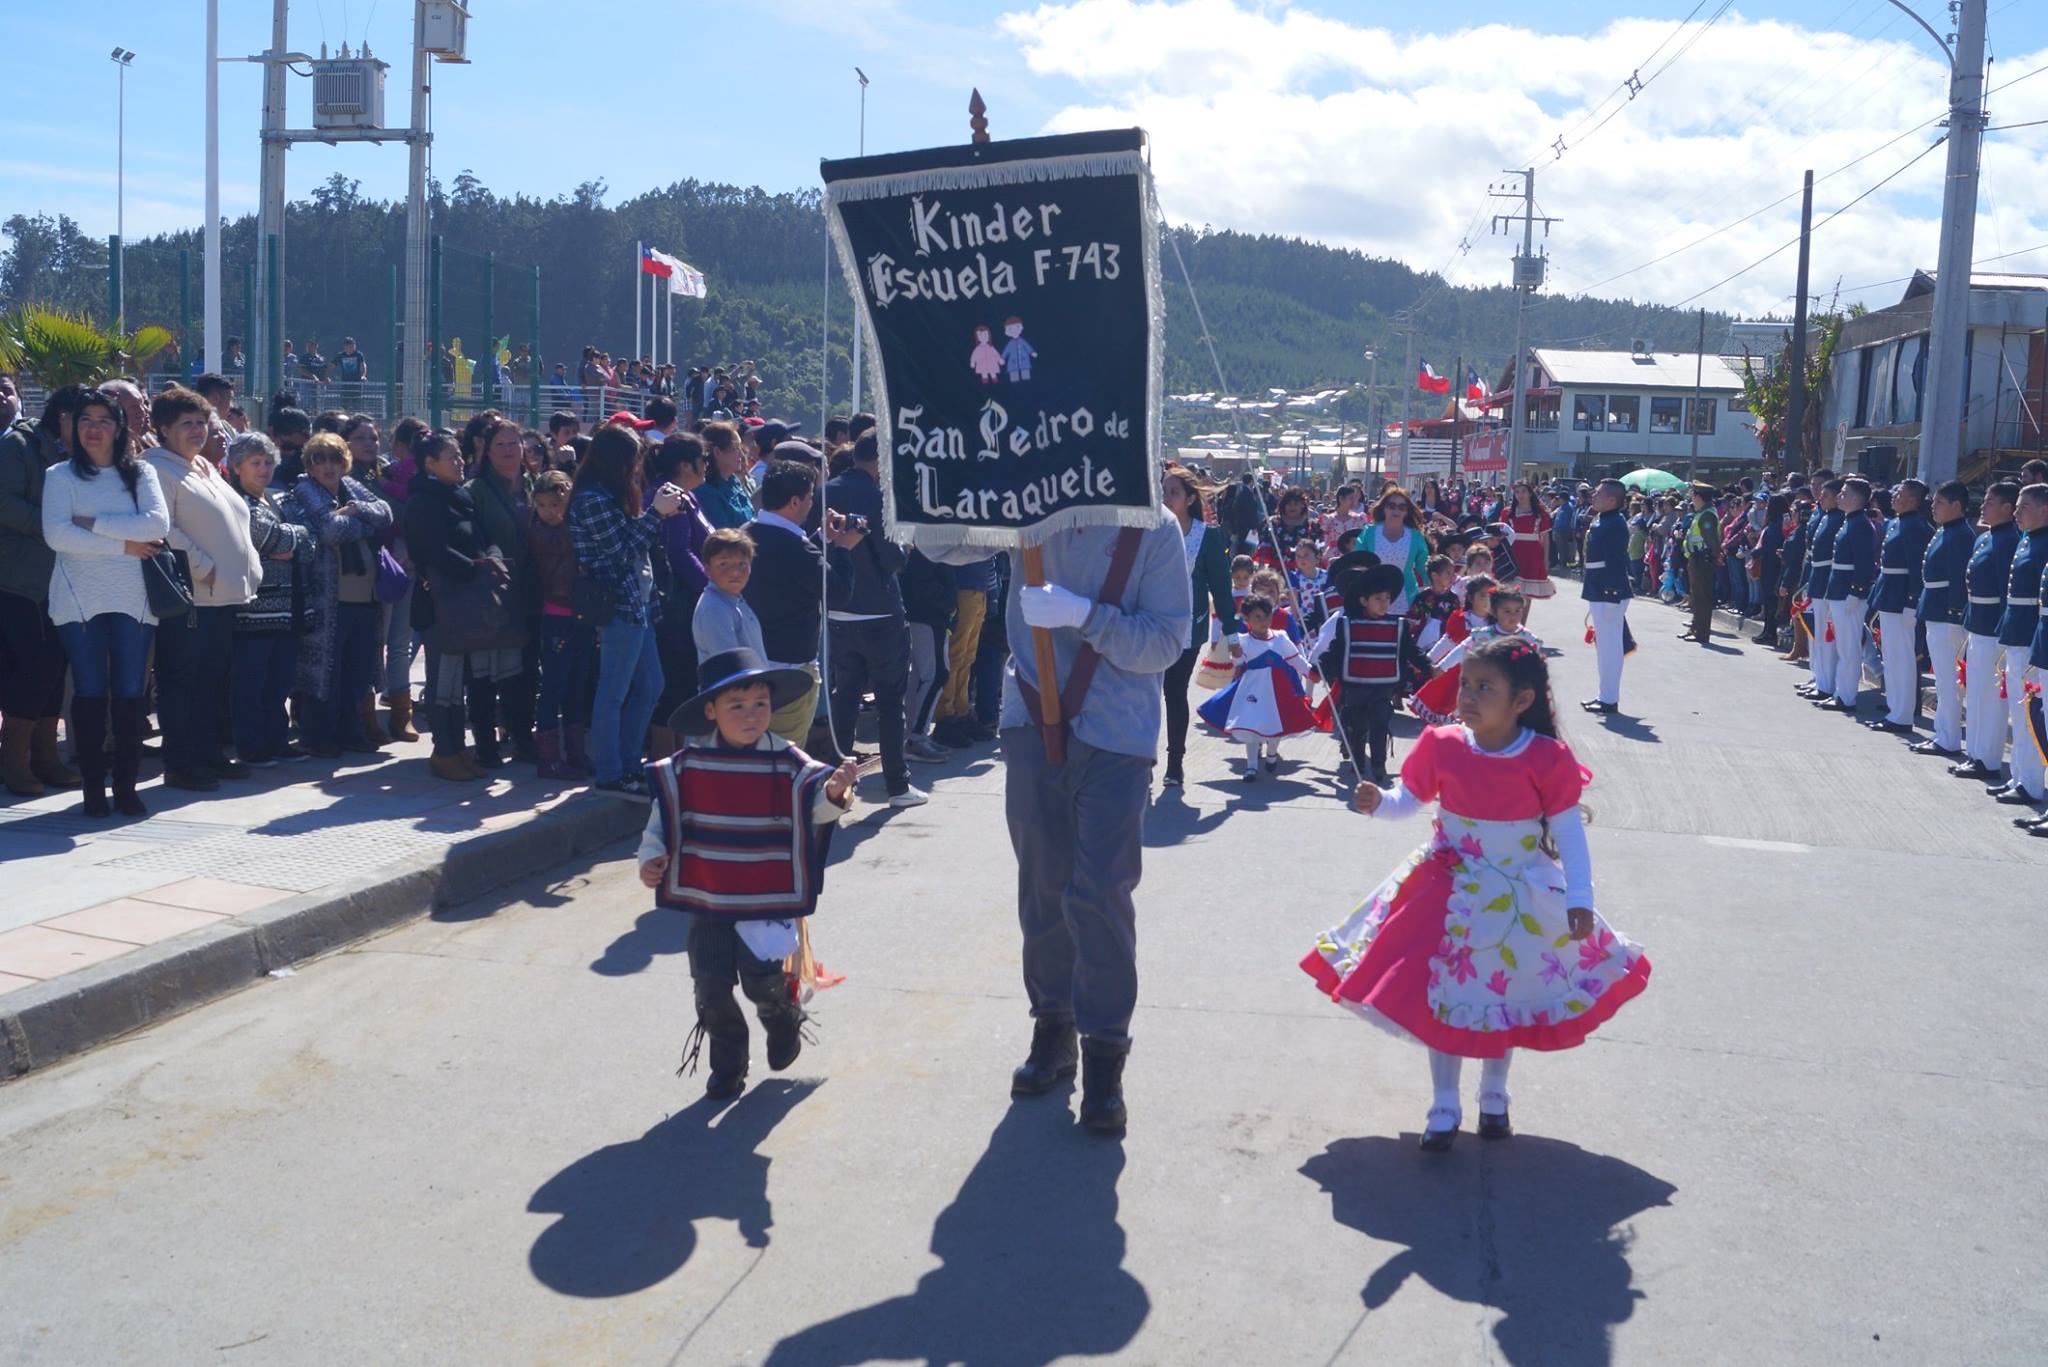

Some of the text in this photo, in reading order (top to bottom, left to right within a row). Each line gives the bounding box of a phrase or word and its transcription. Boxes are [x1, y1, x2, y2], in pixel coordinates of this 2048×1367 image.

[911, 196, 1062, 256] Kinder
[867, 243, 1120, 308] Escuela F-743
[898, 399, 1129, 462] San Pedro de
[914, 456, 1117, 520] Laraquete
